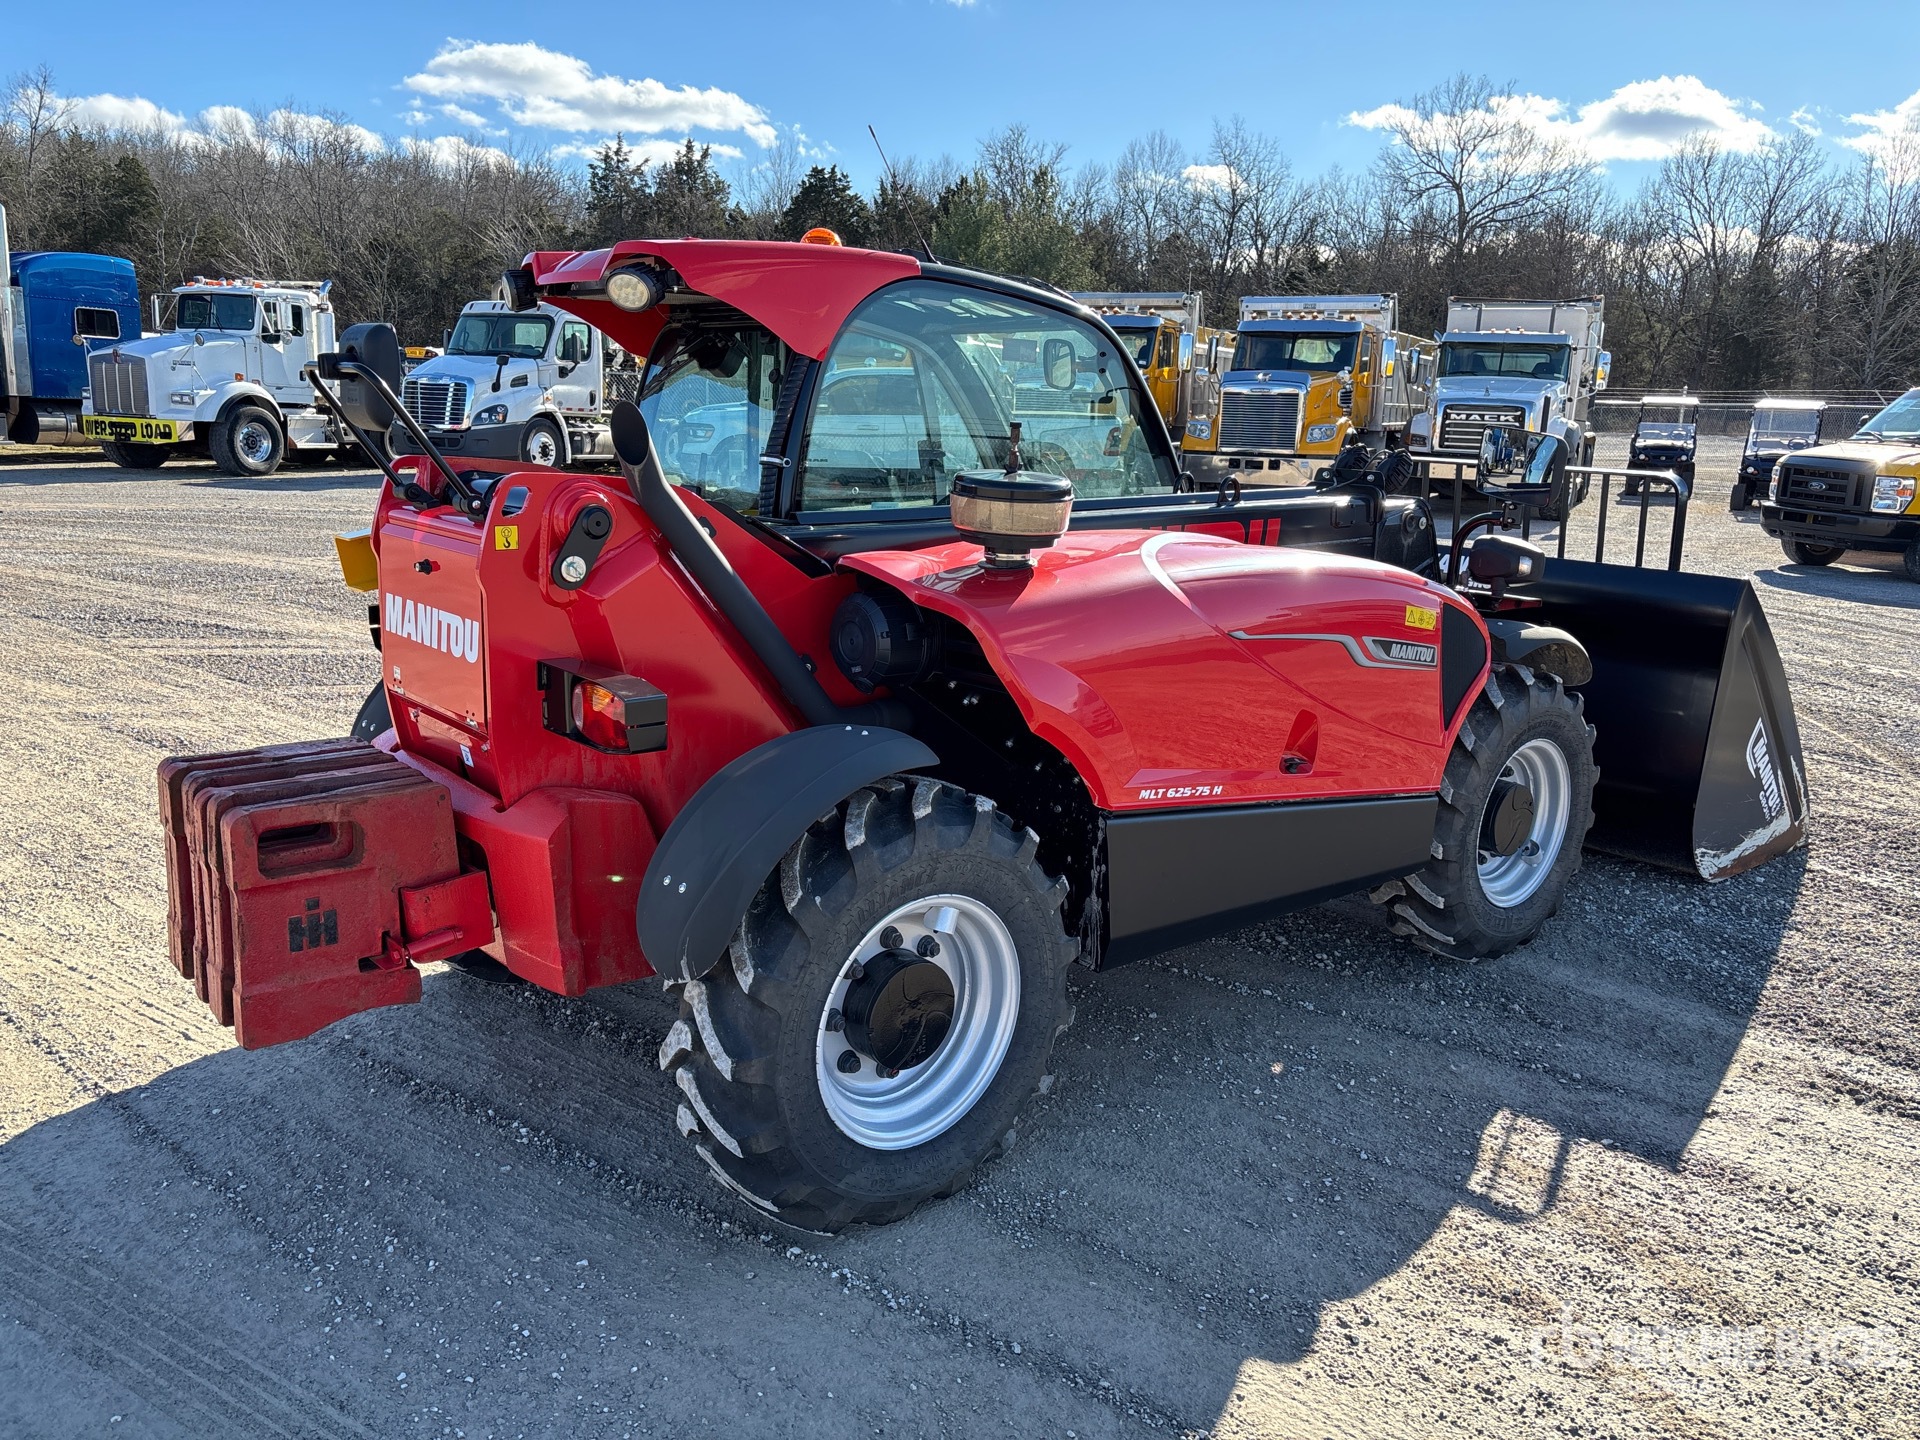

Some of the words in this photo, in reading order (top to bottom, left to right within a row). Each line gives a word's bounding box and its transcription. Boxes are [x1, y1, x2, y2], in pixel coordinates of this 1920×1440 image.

[1450, 413, 1515, 422] MACK
[85, 418, 137, 438] OVERSED
[140, 422, 173, 440] LOAD
[385, 592, 480, 664] MANITOU
[1390, 643, 1435, 662] MANITOU
[1753, 737, 1782, 817] MANITOU
[1138, 788, 1167, 800] MLT
[1166, 785, 1211, 798] 625-75
[1212, 785, 1223, 796] H
